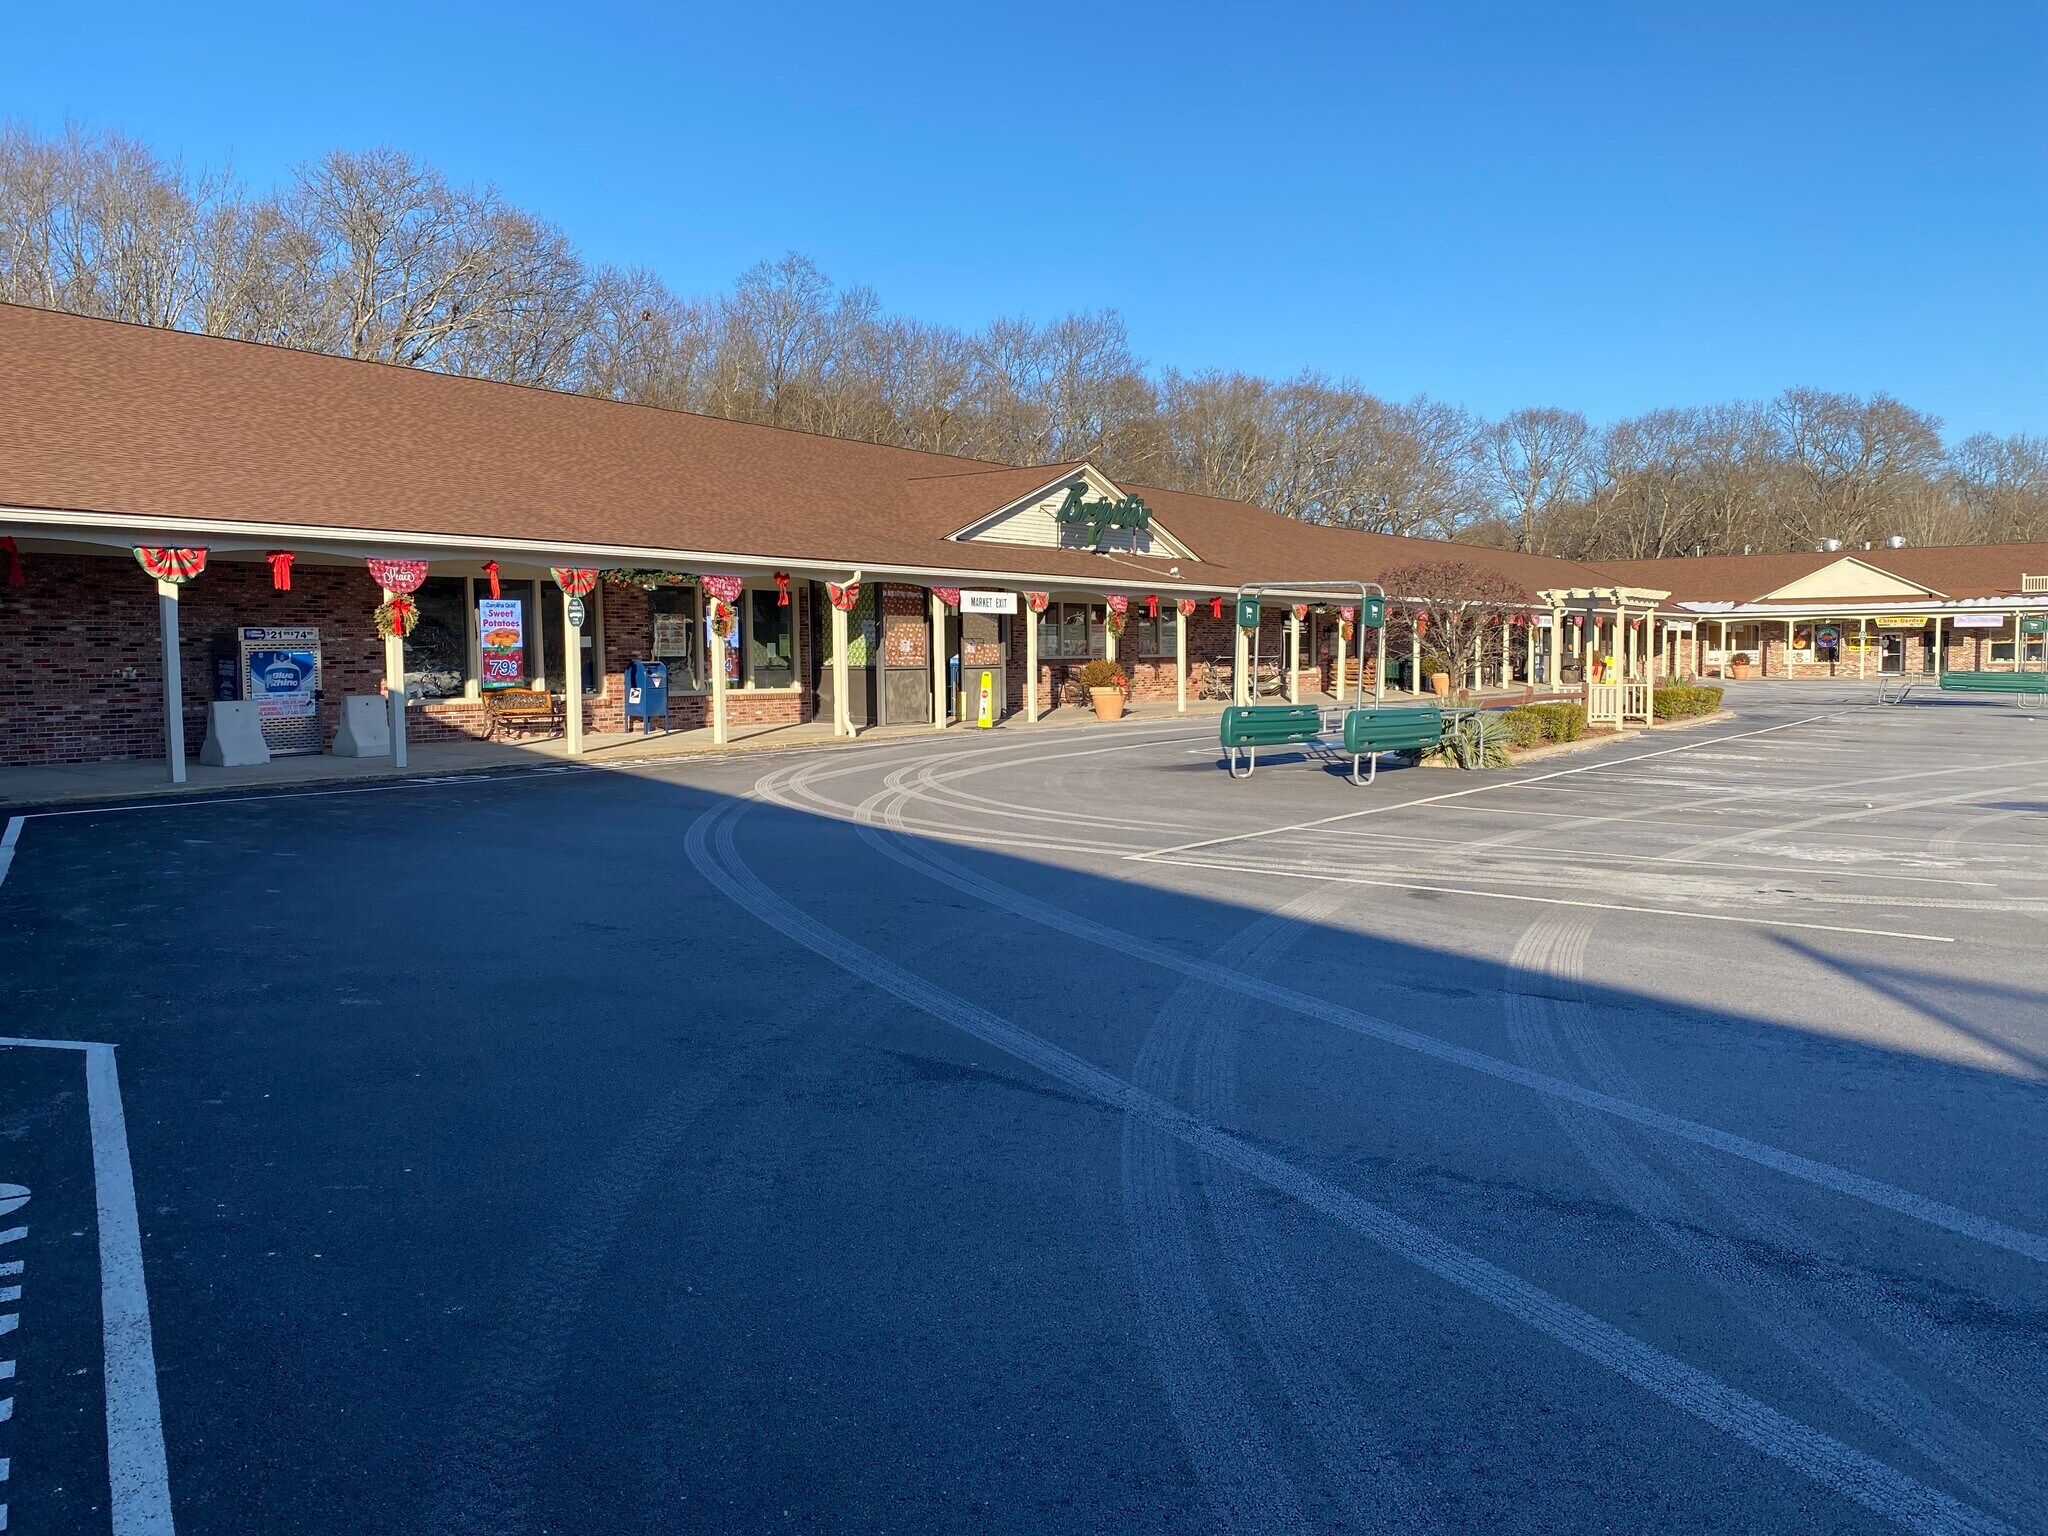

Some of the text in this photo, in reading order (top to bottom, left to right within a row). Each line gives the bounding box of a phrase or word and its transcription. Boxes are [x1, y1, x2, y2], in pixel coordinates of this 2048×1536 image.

[383, 567, 415, 583] Peace
[970, 596, 1007, 608] MARKET EXIT
[488, 609, 514, 617] Sweet
[483, 619, 520, 627] Potatoes
